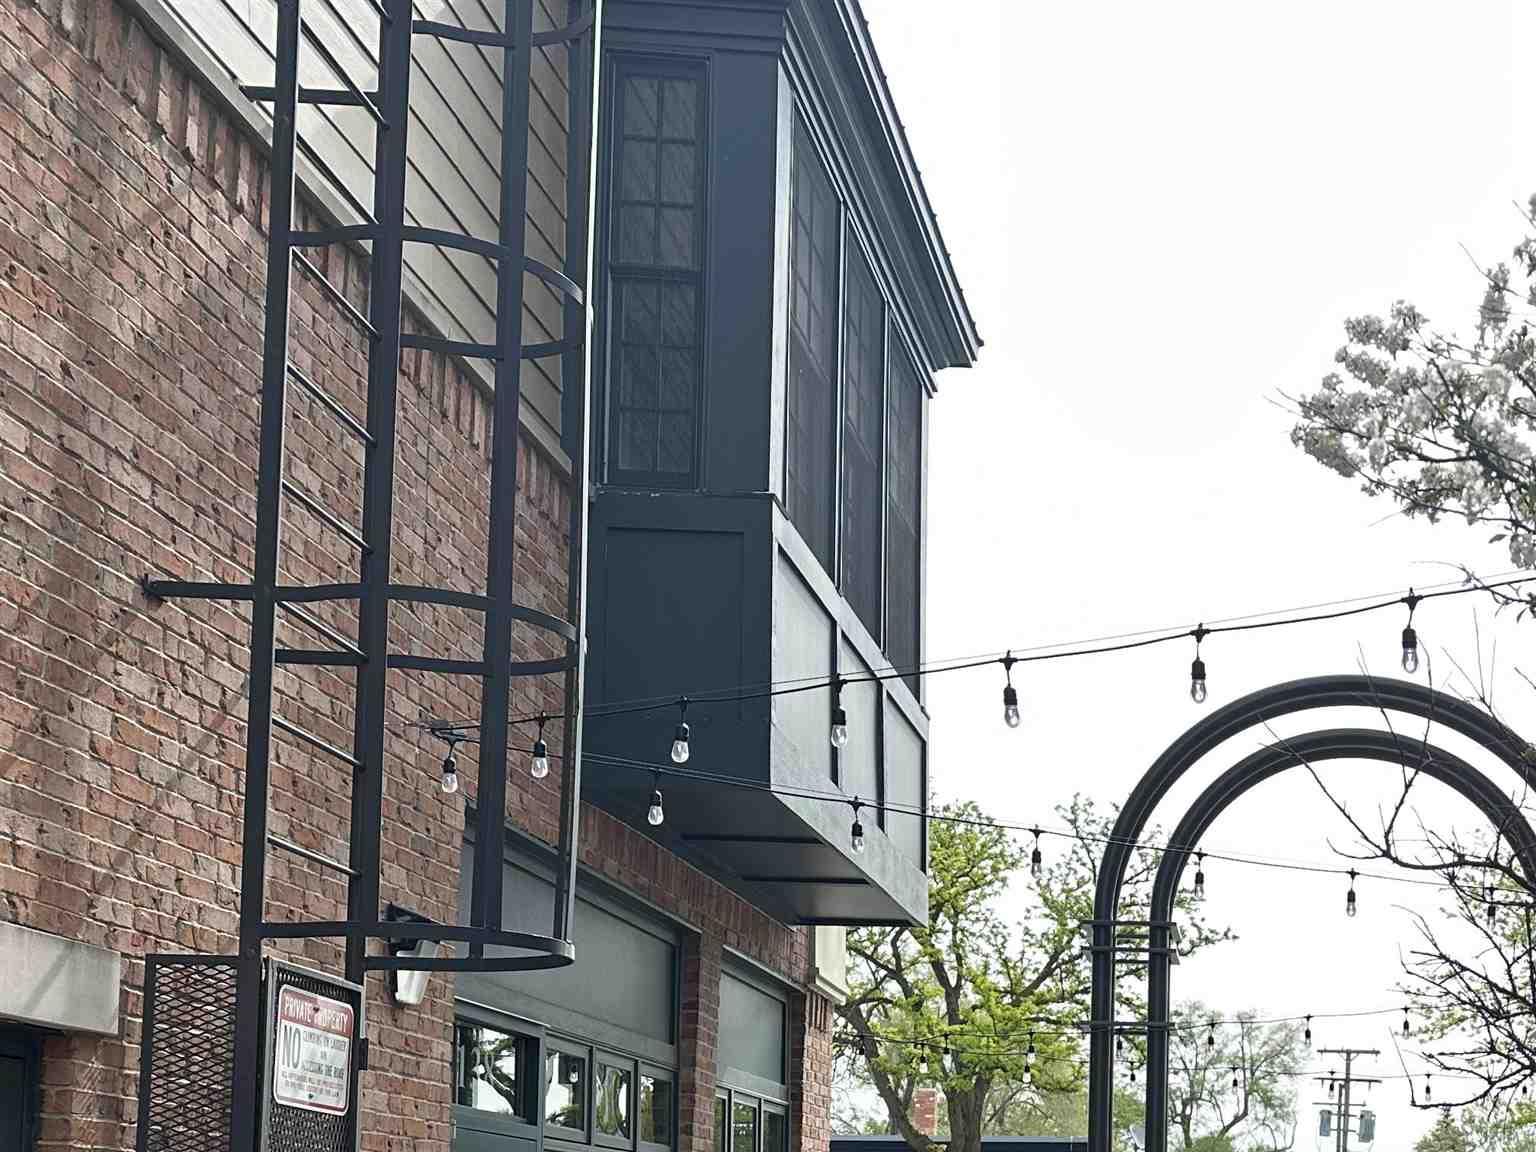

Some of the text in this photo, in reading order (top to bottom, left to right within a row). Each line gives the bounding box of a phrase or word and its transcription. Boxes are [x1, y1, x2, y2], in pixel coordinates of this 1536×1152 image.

[283, 994, 349, 1033] PRIVATE PROPERTY
[282, 1025, 301, 1069] NO
